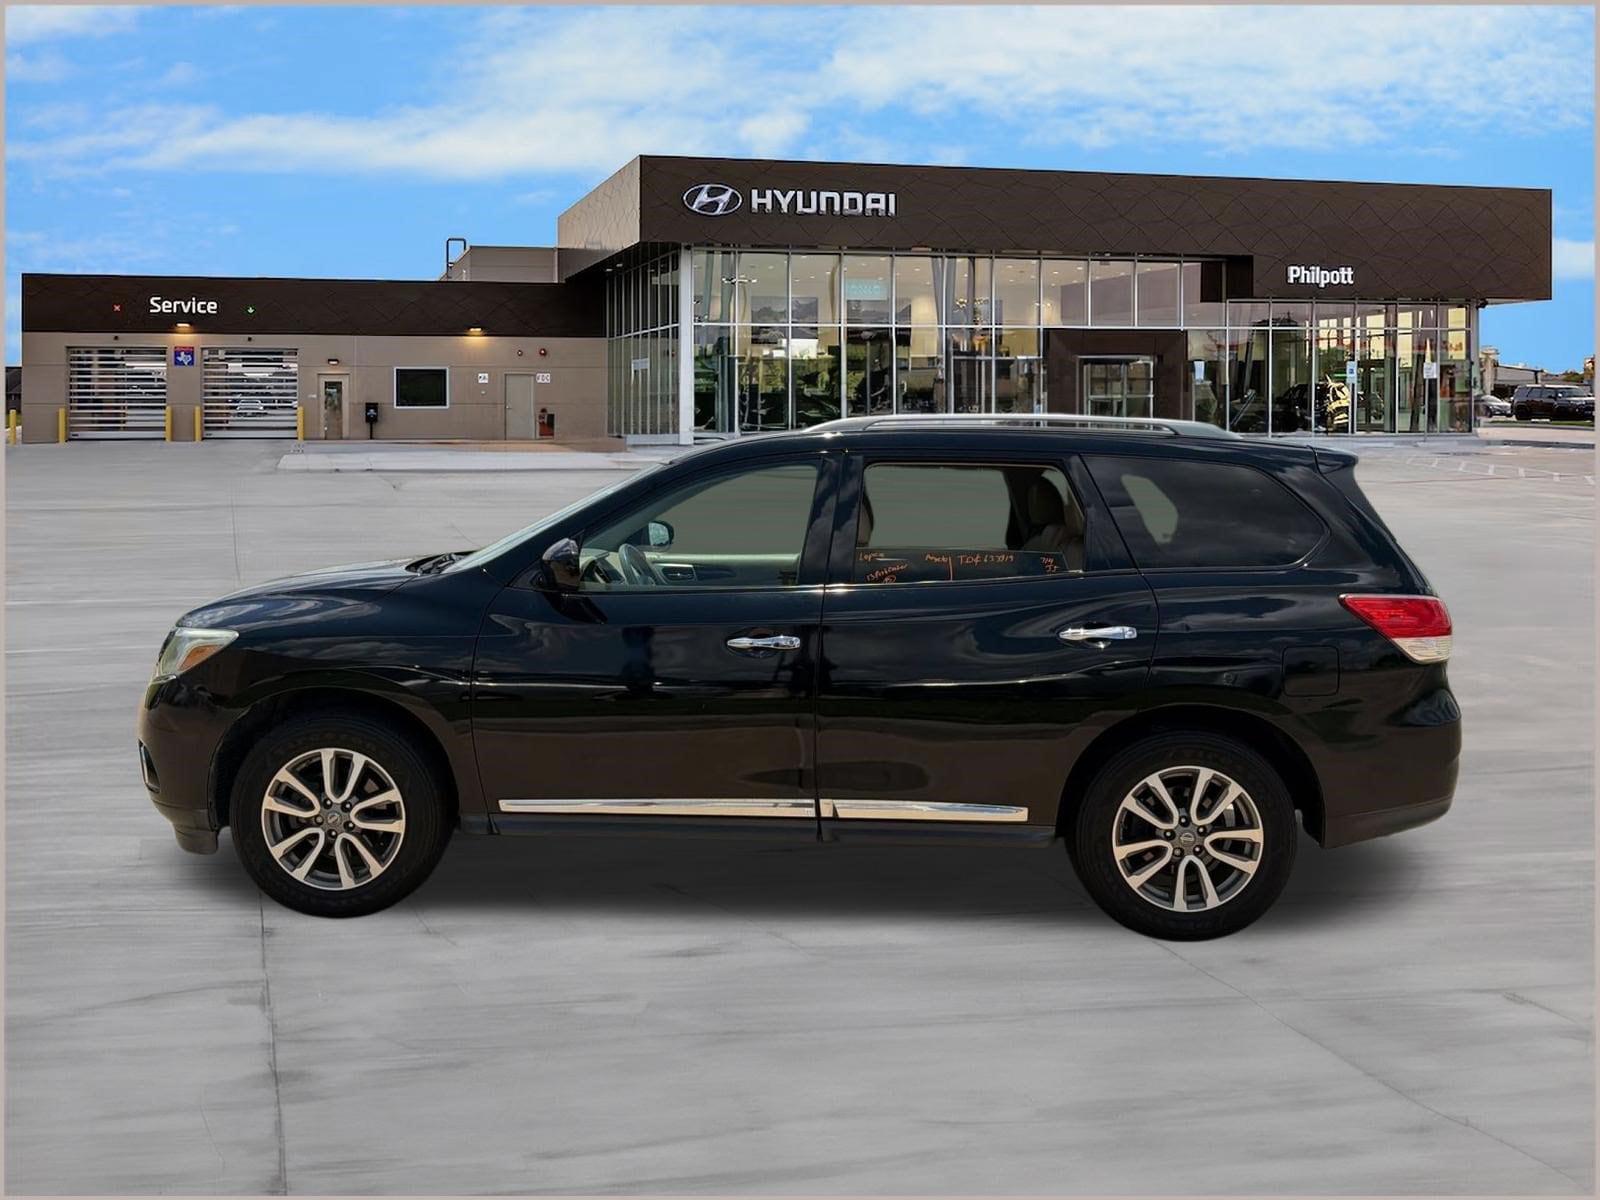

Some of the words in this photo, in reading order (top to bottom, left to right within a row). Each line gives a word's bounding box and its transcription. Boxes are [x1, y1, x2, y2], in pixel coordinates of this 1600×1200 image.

[751, 188, 896, 216] HYUNDAI
[1287, 265, 1354, 288] Philpott
[149, 296, 218, 315] Service
